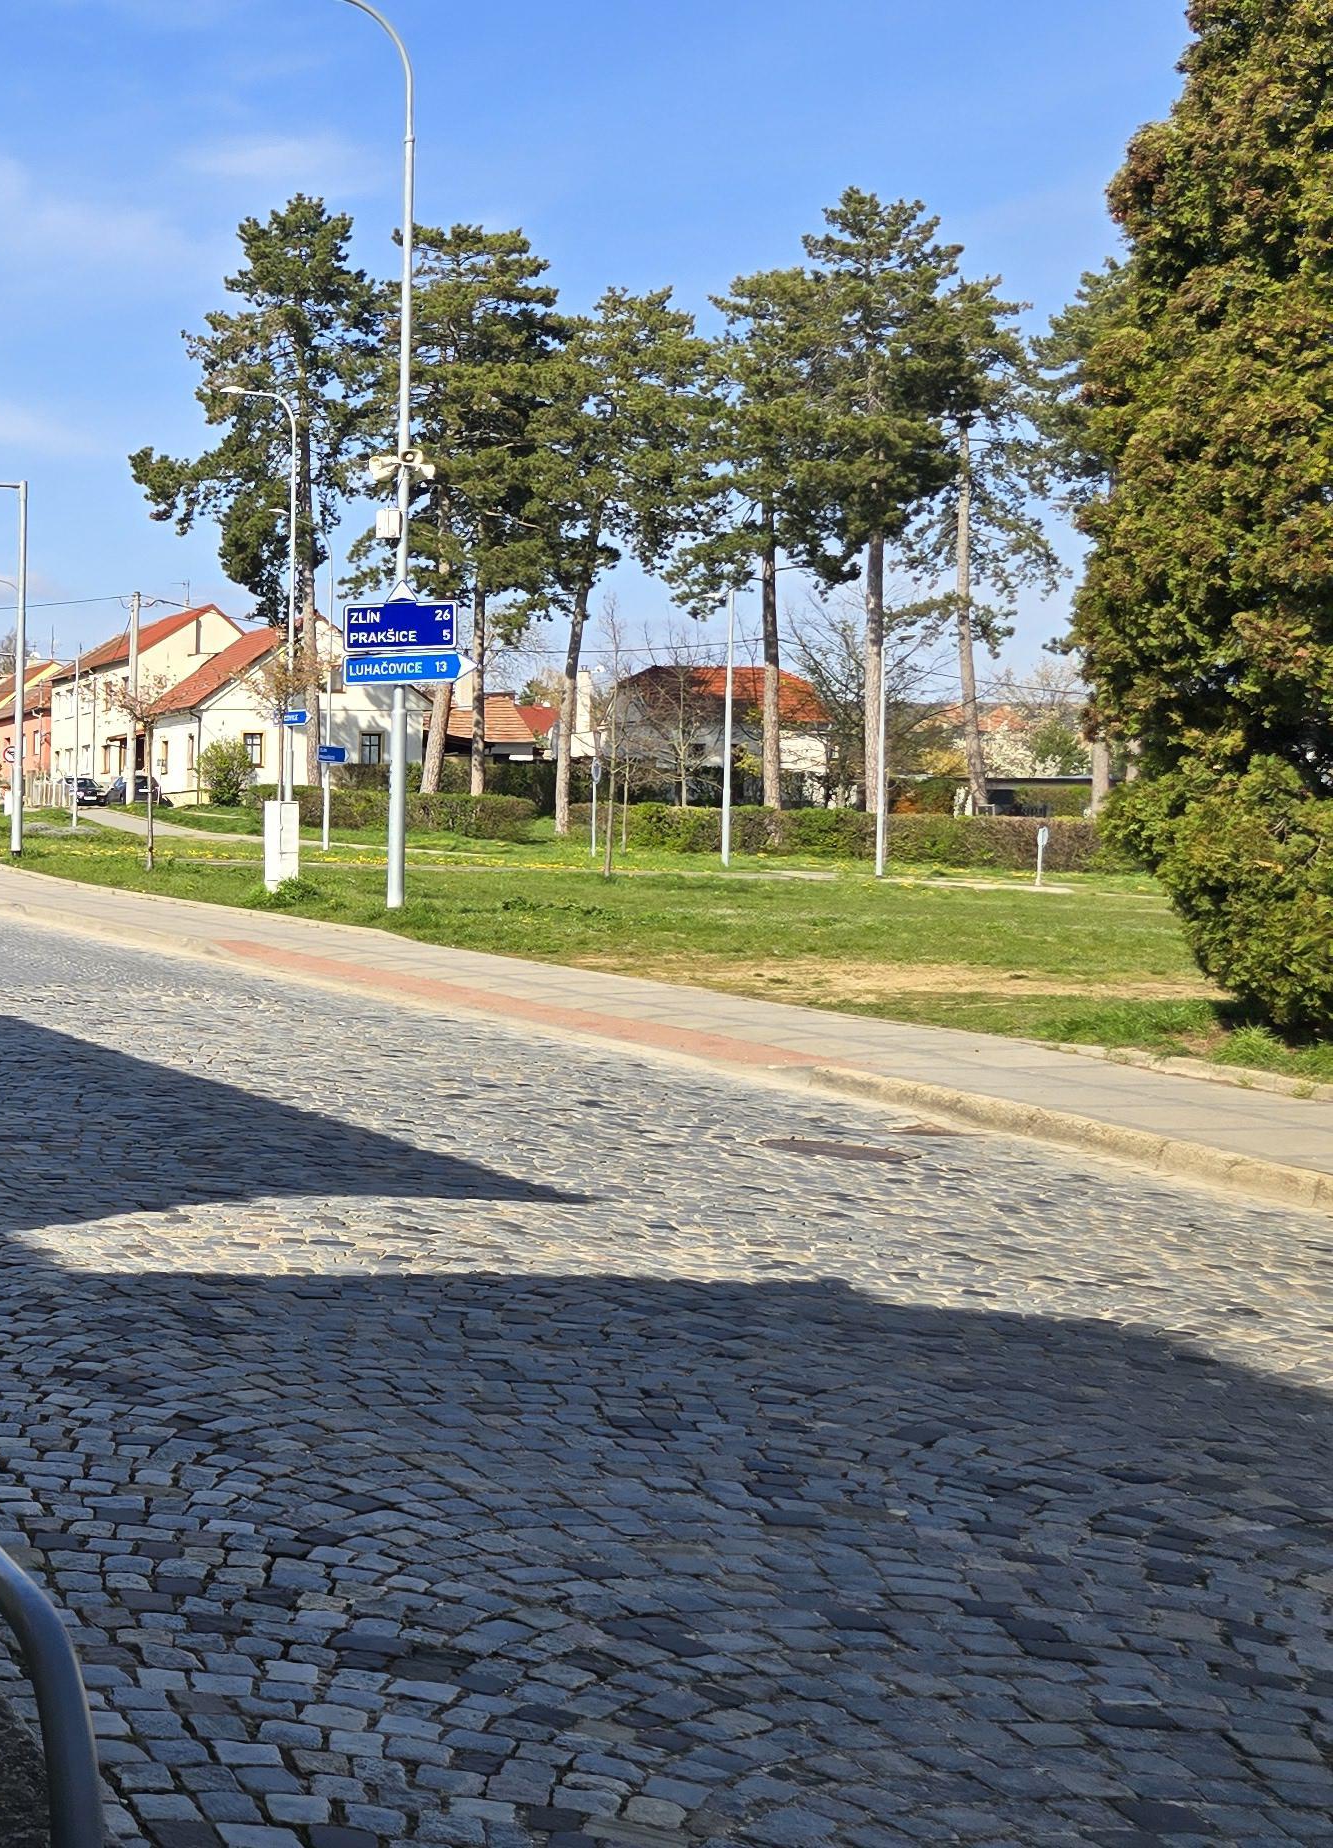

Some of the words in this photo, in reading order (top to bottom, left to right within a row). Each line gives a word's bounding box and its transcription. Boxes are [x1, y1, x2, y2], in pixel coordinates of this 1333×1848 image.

[349, 609, 381, 624] ZLÍN
[434, 608, 451, 621] 26
[349, 628, 417, 643] PRAKŠICE
[442, 629, 451, 641] 5
[349, 661, 423, 676] LUHAČOVICE
[435, 661, 448, 673] 13
